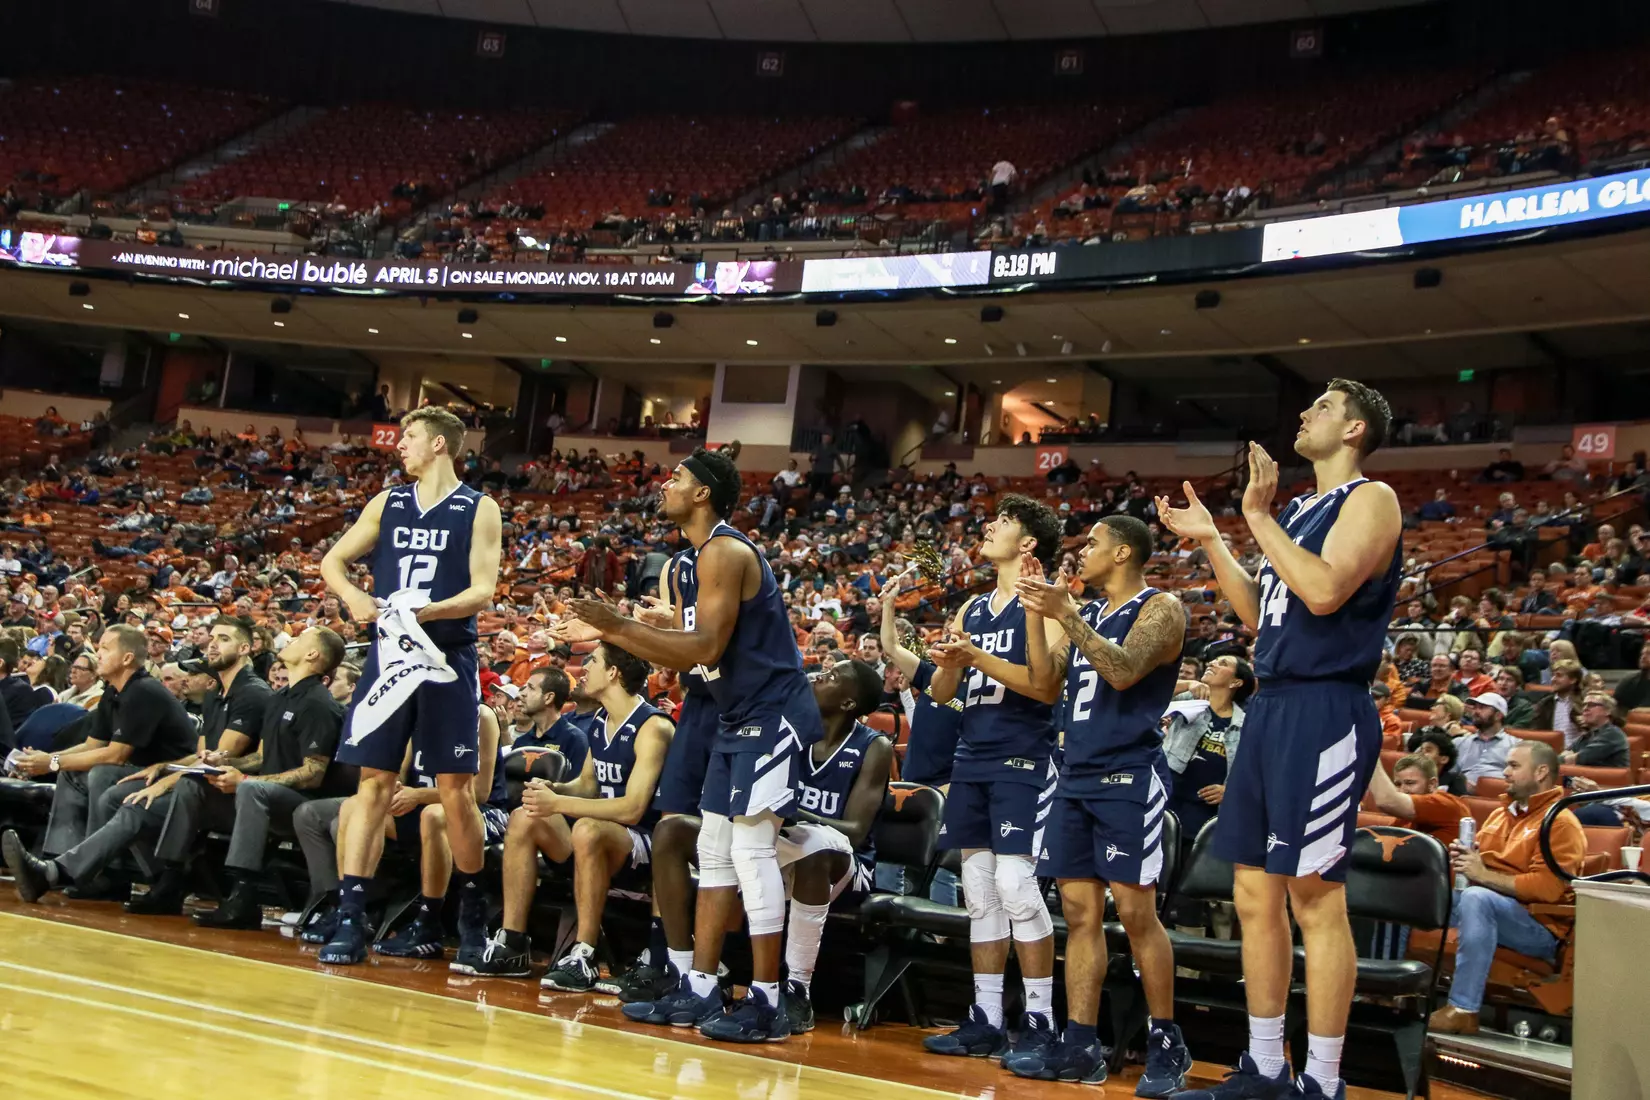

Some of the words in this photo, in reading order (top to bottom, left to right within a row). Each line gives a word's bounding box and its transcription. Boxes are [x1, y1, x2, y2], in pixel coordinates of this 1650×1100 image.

[762, 59, 779, 71] 62
[1061, 56, 1078, 69] 61
[1460, 186, 1590, 229] HARLEM
[117, 252, 134, 264] AN
[134, 253, 178, 268] EVENING
[178, 257, 205, 270] WITH
[212, 256, 298, 281] michael
[303, 260, 368, 285] bublé
[374, 266, 424, 284] APRIL
[427, 267, 439, 284] 5
[450, 270, 473, 284] ON
[474, 270, 504, 284] SALE
[506, 271, 566, 286] MONDAY,
[568, 272, 600, 286] NOV.
[604, 272, 619, 286] 18
[620, 272, 638, 285] AT
[640, 272, 674, 285] 10AM
[993, 254, 1029, 278] 8:19
[1030, 251, 1057, 277] PM
[375, 430, 396, 445] 22
[1577, 432, 1610, 454] 49
[1039, 452, 1062, 469] 20
[393, 526, 450, 552] CBU
[398, 554, 438, 595] 12
[1073, 670, 1099, 722] 2
[839, 761, 854, 769] WAC
